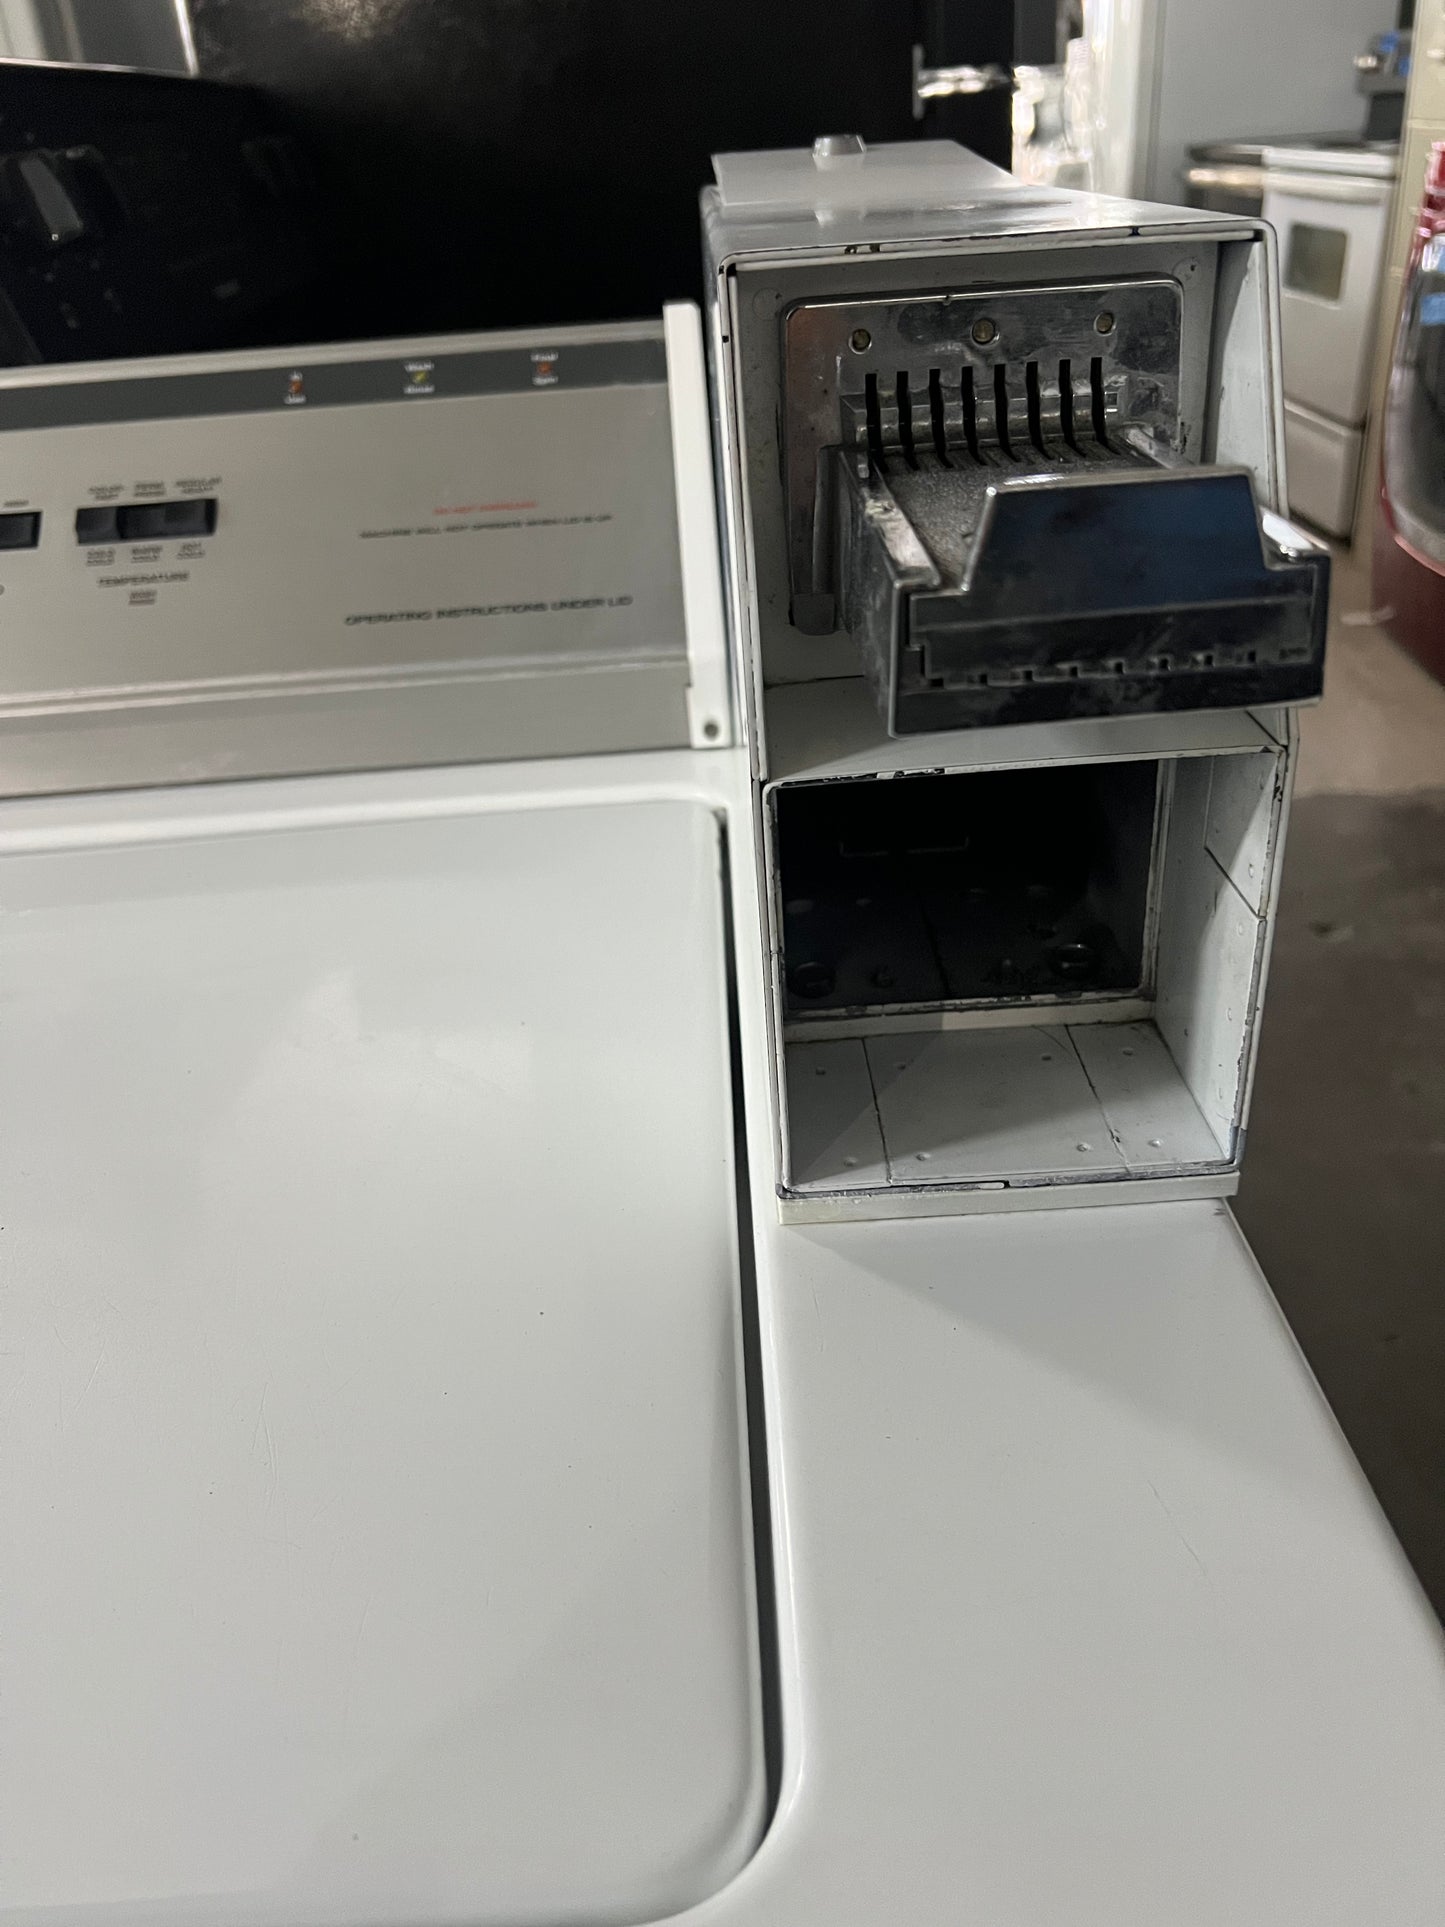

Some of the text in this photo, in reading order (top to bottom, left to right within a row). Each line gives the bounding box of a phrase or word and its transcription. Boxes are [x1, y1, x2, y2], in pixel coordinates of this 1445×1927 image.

[345, 595, 633, 626] OPERATING INSTRUCTIONS UNDER LID
